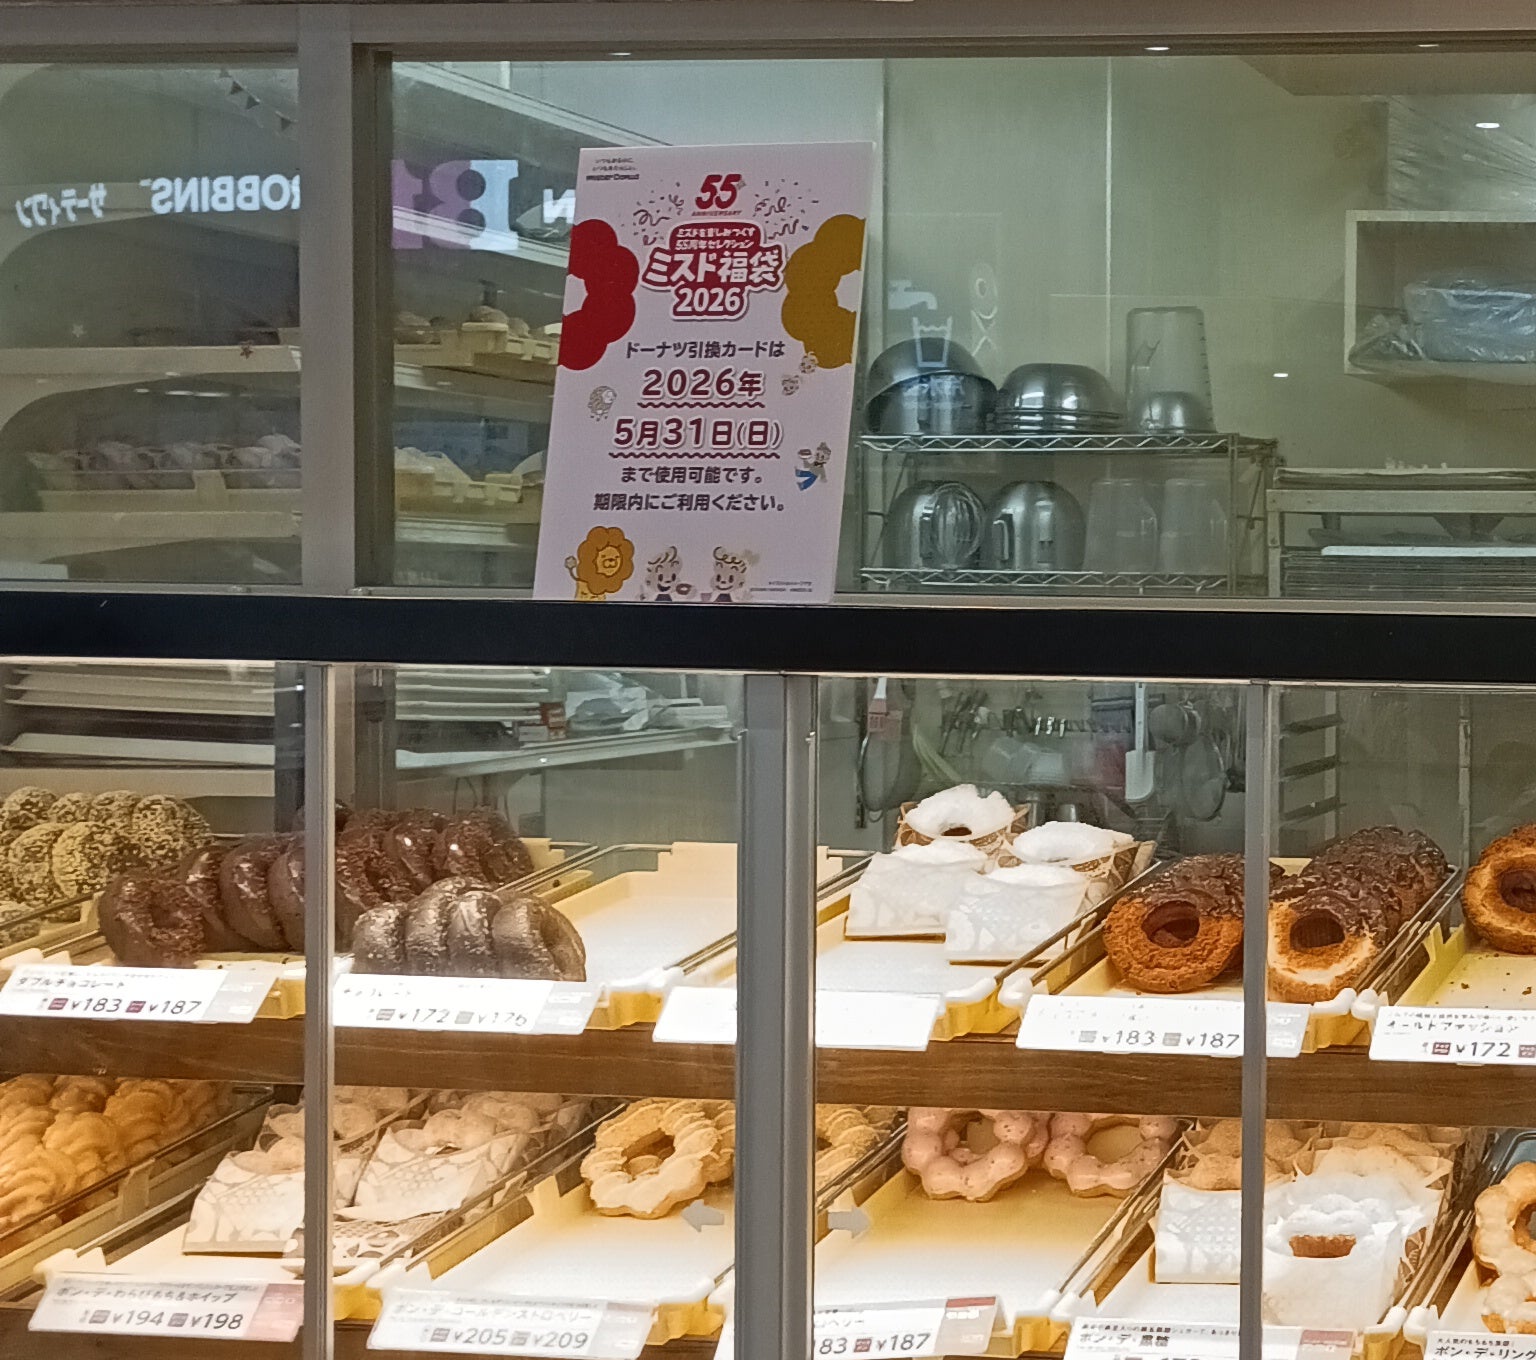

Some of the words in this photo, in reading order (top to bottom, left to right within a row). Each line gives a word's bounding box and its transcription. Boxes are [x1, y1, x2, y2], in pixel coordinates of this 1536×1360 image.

[695, 173, 743, 210] 55
[645, 249, 781, 285] ミスド福袋
[675, 287, 741, 313] 2026
[626, 340, 785, 359] ドーナツ引換カードは
[642, 369, 764, 397] 2026年
[621, 467, 763, 484] まで使用可能です。
[593, 493, 785, 512] 期限内にご利用ください。
[16, 976, 125, 990] ダブルチョコレート
